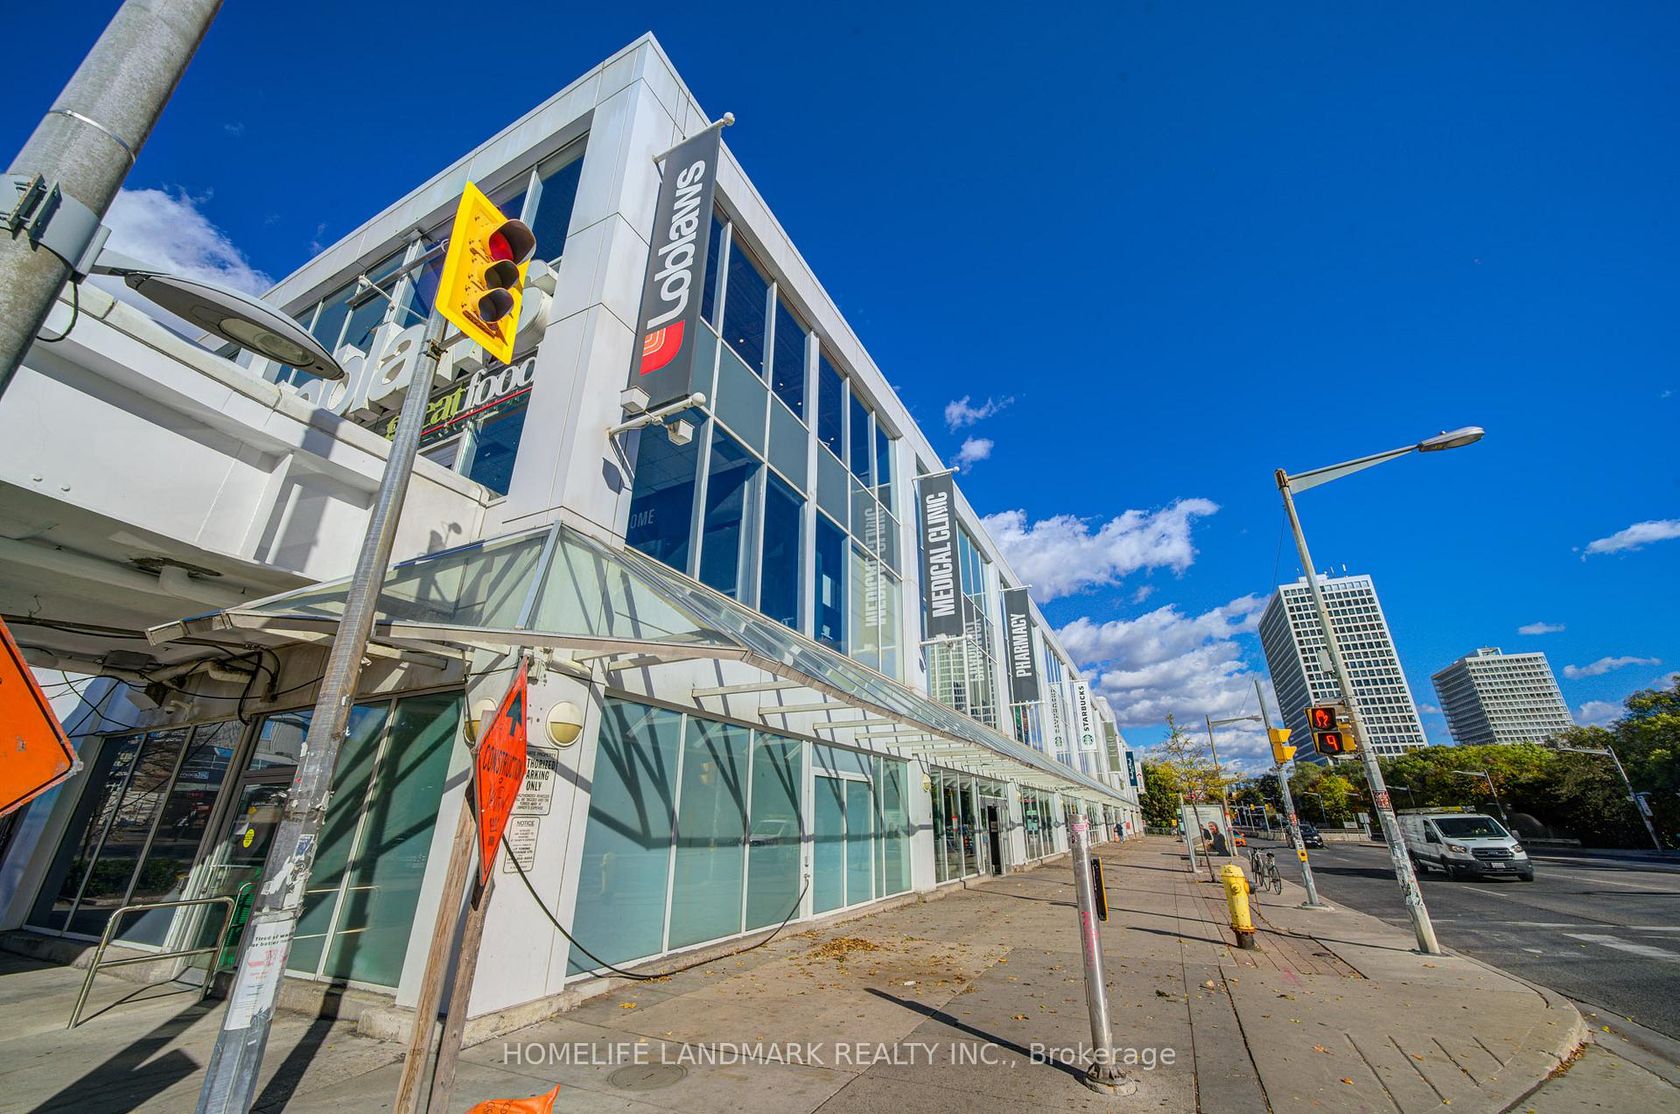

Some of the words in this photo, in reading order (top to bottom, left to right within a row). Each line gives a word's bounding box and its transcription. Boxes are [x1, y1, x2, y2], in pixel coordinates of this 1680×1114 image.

[646, 159, 706, 330] Loblaws
[630, 508, 655, 529] OME
[925, 490, 951, 542] CLINIC
[926, 543, 956, 618] MEDICAL
[1010, 613, 1032, 678] PHARMACY
[1079, 686, 1089, 731] STARBUCKS
[1326, 735, 1338, 751] 9
[525, 769, 550, 781] ARKING
[527, 758, 556, 770] THORIZED
[525, 780, 542, 791] ONLY
